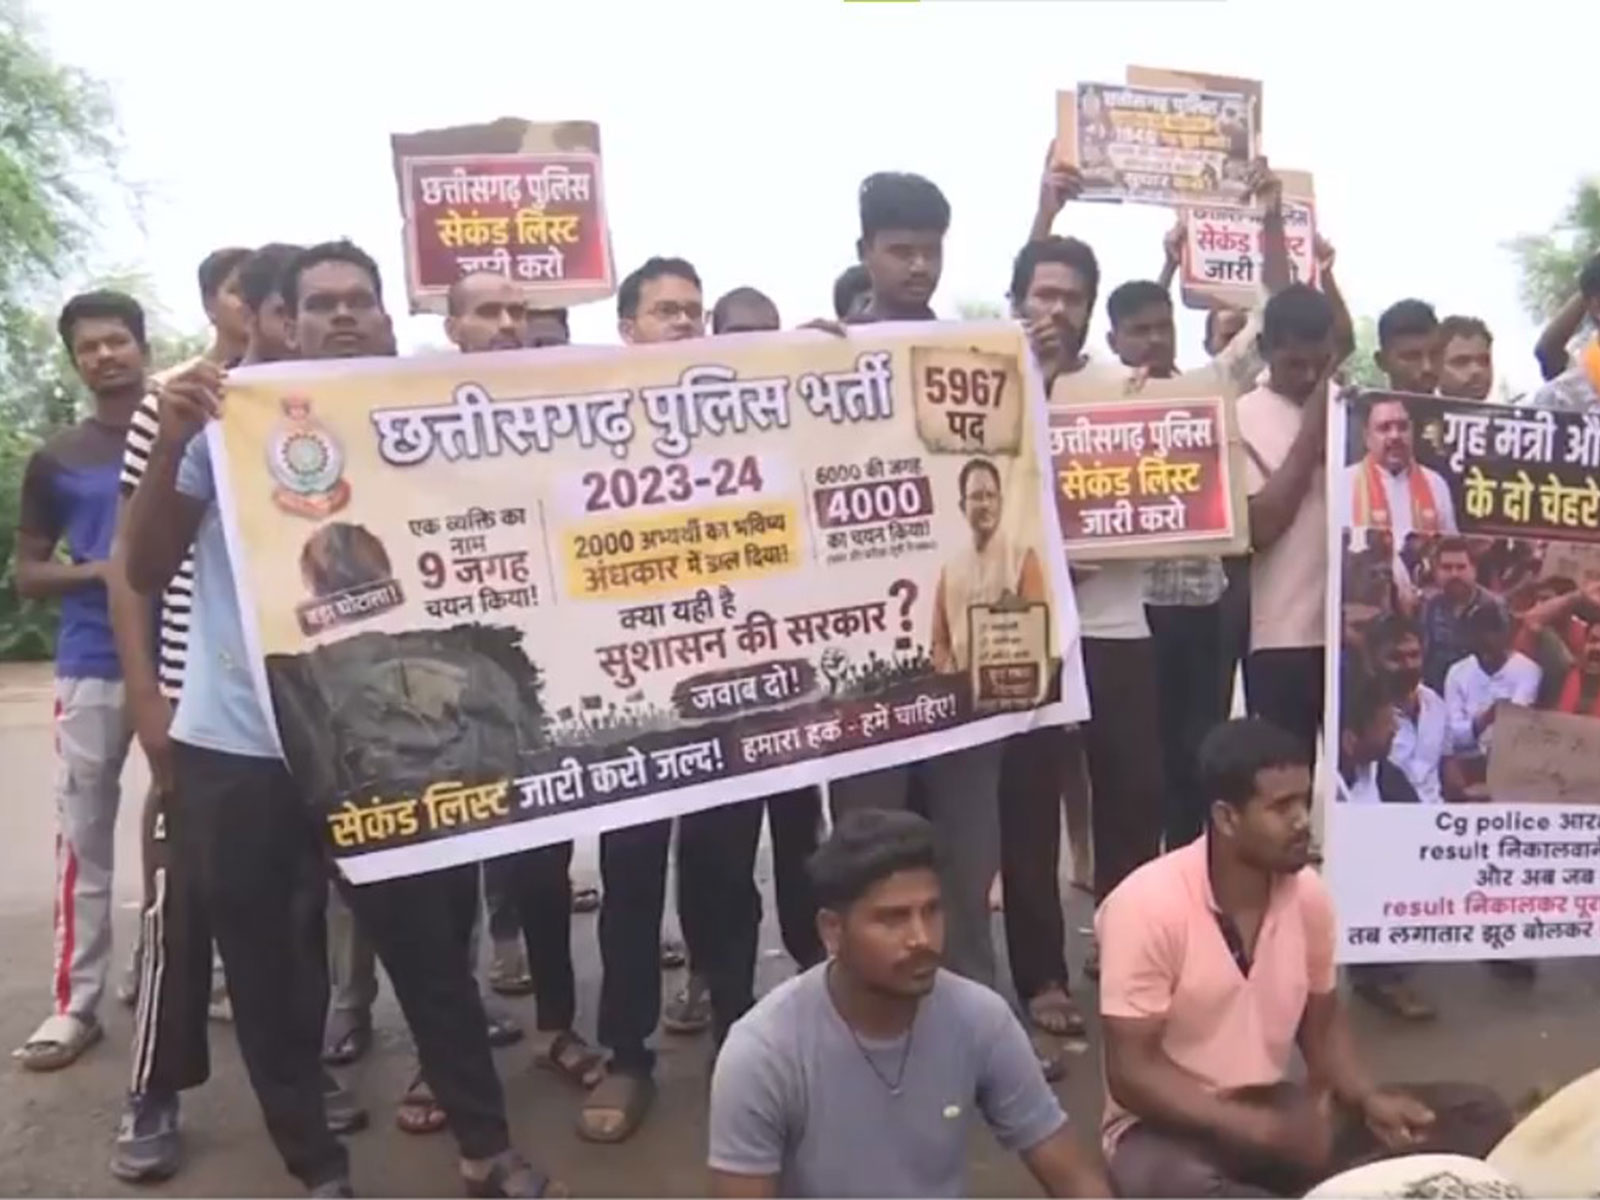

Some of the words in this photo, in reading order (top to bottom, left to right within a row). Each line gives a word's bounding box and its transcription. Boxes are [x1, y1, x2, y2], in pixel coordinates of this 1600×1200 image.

[421, 166, 521, 208] छत्तीसगढ़
[526, 165, 591, 209] पुलिस
[435, 209, 510, 246] सेकंड
[515, 208, 580, 244] लिस्ट
[1196, 223, 1251, 253] सेकंड
[516, 246, 564, 279] करो
[1204, 256, 1254, 282] जारी
[924, 366, 1007, 410] 5967
[370, 381, 634, 467] छत्तीसगढ़
[640, 364, 791, 459] पुलिस
[798, 350, 896, 423] भर्ती
[945, 409, 987, 444] पद
[1148, 411, 1212, 457] पुलिस
[1443, 412, 1489, 473] गृह
[1493, 408, 1558, 463] मंत्री
[1563, 412, 1600, 467] औ
[582, 456, 763, 512] 2023-24
[815, 464, 862, 485] 6000
[866, 457, 885, 478] की
[888, 457, 923, 475] जगह
[1058, 460, 1132, 499] सेकंड
[1137, 456, 1202, 495] लिस्ट
[828, 481, 922, 523] 4000
[1078, 501, 1134, 535] जारी
[1138, 496, 1187, 532] करो
[1464, 465, 1498, 518] के
[1502, 470, 1535, 523] दो
[1539, 472, 1600, 528] चेहरे
[408, 517, 441, 537] एक
[446, 506, 498, 533] व्यक्ति
[501, 507, 527, 527] का
[573, 528, 635, 561] 2000
[639, 518, 702, 551] अभ्यर्थी
[705, 520, 731, 543] का
[734, 510, 787, 537] भविष्य
[826, 531, 848, 550] का
[851, 526, 885, 546] चयन
[450, 535, 487, 555] नाम
[706, 550, 741, 574] डाल
[418, 551, 447, 590] 9
[453, 551, 531, 585] जगह
[424, 595, 475, 619] चयन
[480, 584, 539, 614] किया!
[618, 603, 666, 631] क्या
[672, 588, 715, 626] यही
[718, 584, 738, 619] है
[595, 625, 728, 689] सुशासन
[732, 610, 779, 653] की
[690, 676, 757, 711] जवाब
[760, 665, 801, 697] दो!
[741, 727, 802, 763] हमारा
[327, 796, 419, 847] सेकंड
[423, 780, 511, 829] लिस्ट
[513, 757, 585, 810] जारी
[588, 746, 648, 793] करो
[650, 737, 725, 781] जल्द!
[1435, 811, 1469, 837] Cg
[1475, 811, 1551, 836] police
[1560, 813, 1600, 832] आर
[1419, 842, 1490, 861] result
[1475, 864, 1513, 887] और
[1521, 868, 1557, 887] अब
[1562, 868, 1596, 887] जब
[1382, 897, 1456, 917] result
[1463, 891, 1568, 915] निकालकर
[1573, 895, 1600, 920] पूर
[1347, 926, 1381, 946] तब
[1388, 924, 1475, 945] लगातार
[1481, 925, 1517, 950] झूठ
[1523, 916, 1595, 941] बोलकर
